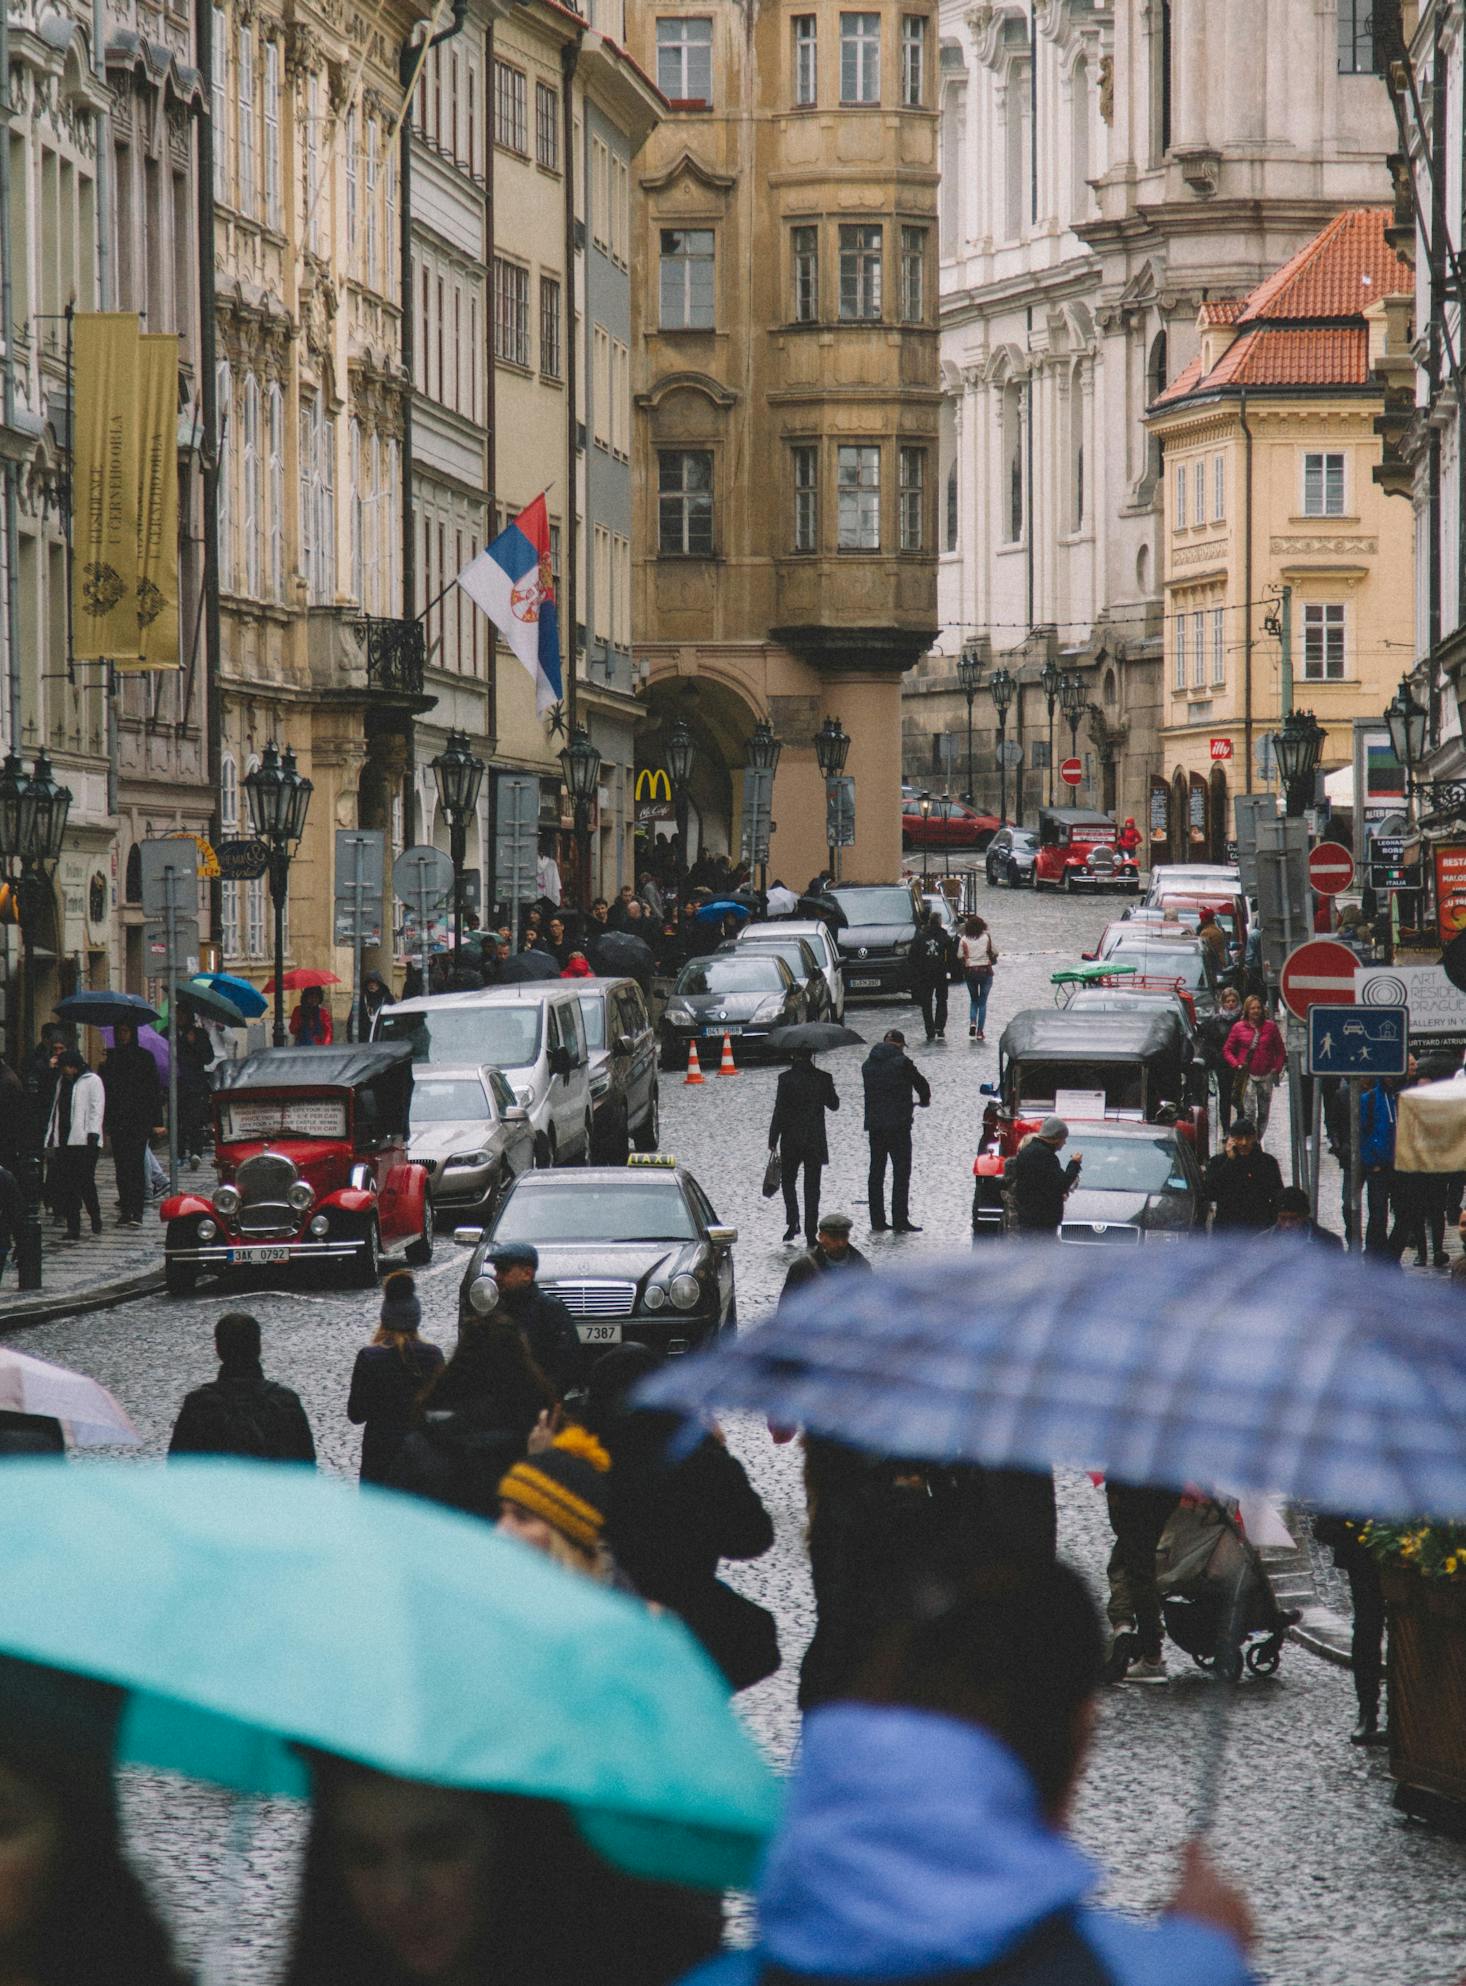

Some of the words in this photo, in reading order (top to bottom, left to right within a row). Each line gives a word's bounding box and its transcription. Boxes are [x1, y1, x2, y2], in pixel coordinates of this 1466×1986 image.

[110, 415, 122, 456] ORLA
[90, 464, 103, 545] RESIDENCE
[212, 741, 230, 758] illy
[1411, 973, 1436, 984] ART
[633, 1153, 671, 1164] TAXI
[235, 1249, 253, 1260] 3AK
[260, 1249, 285, 1260] 0792
[586, 1327, 616, 1339] 7387
